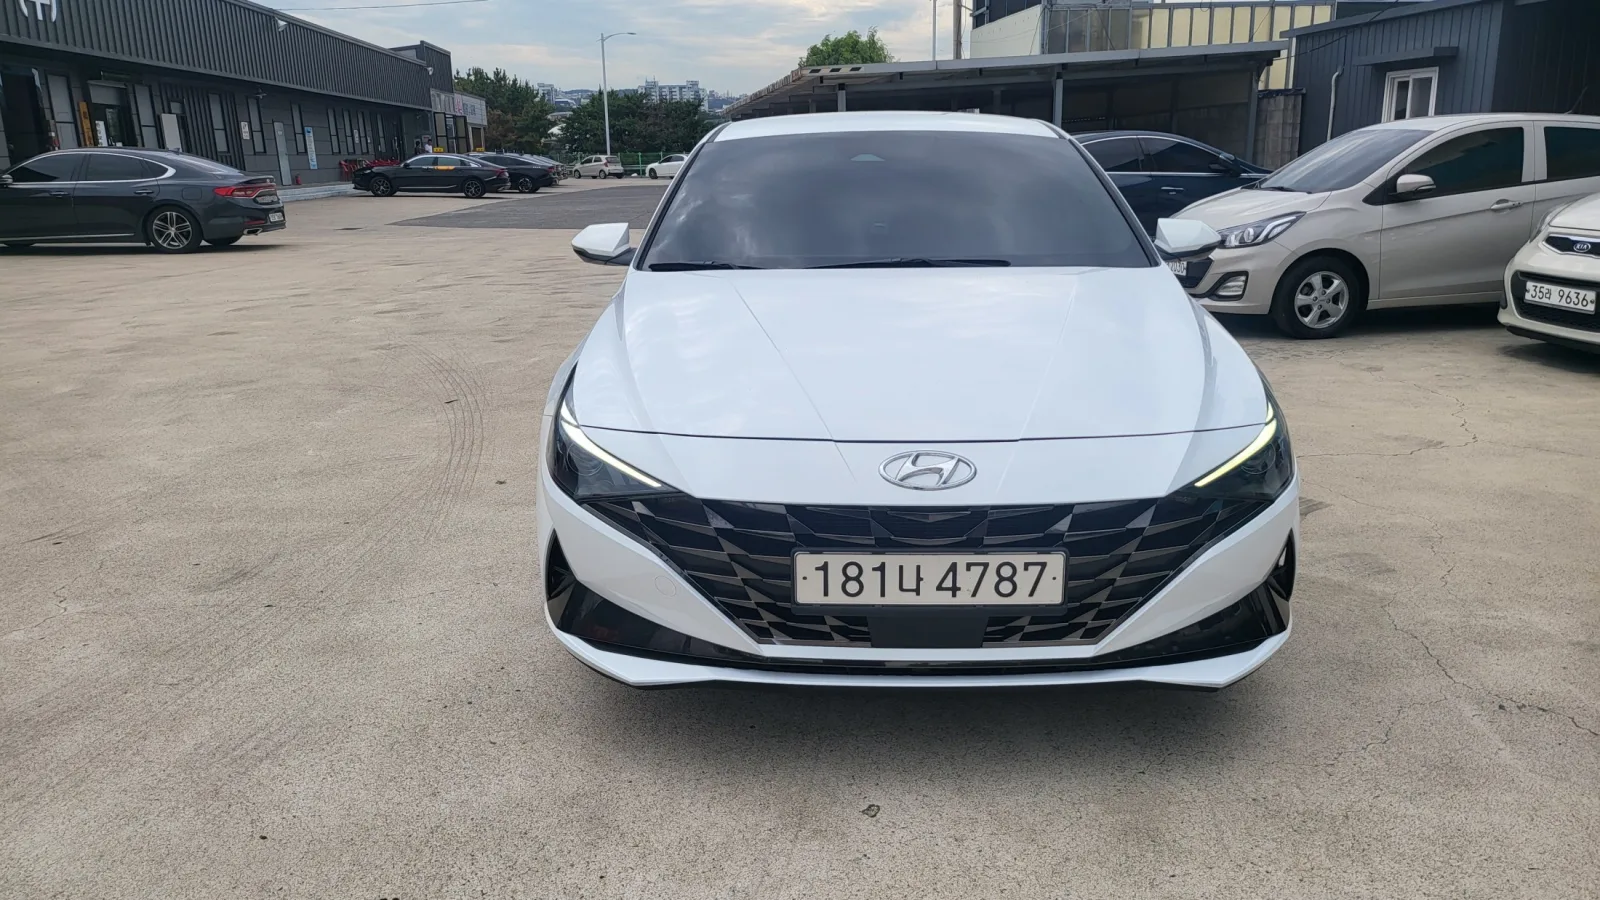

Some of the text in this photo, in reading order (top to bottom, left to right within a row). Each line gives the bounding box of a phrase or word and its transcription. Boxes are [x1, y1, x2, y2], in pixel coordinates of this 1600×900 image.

[1531, 285, 1589, 307] 35라 9636
[814, 561, 1048, 597] 181나 4787
